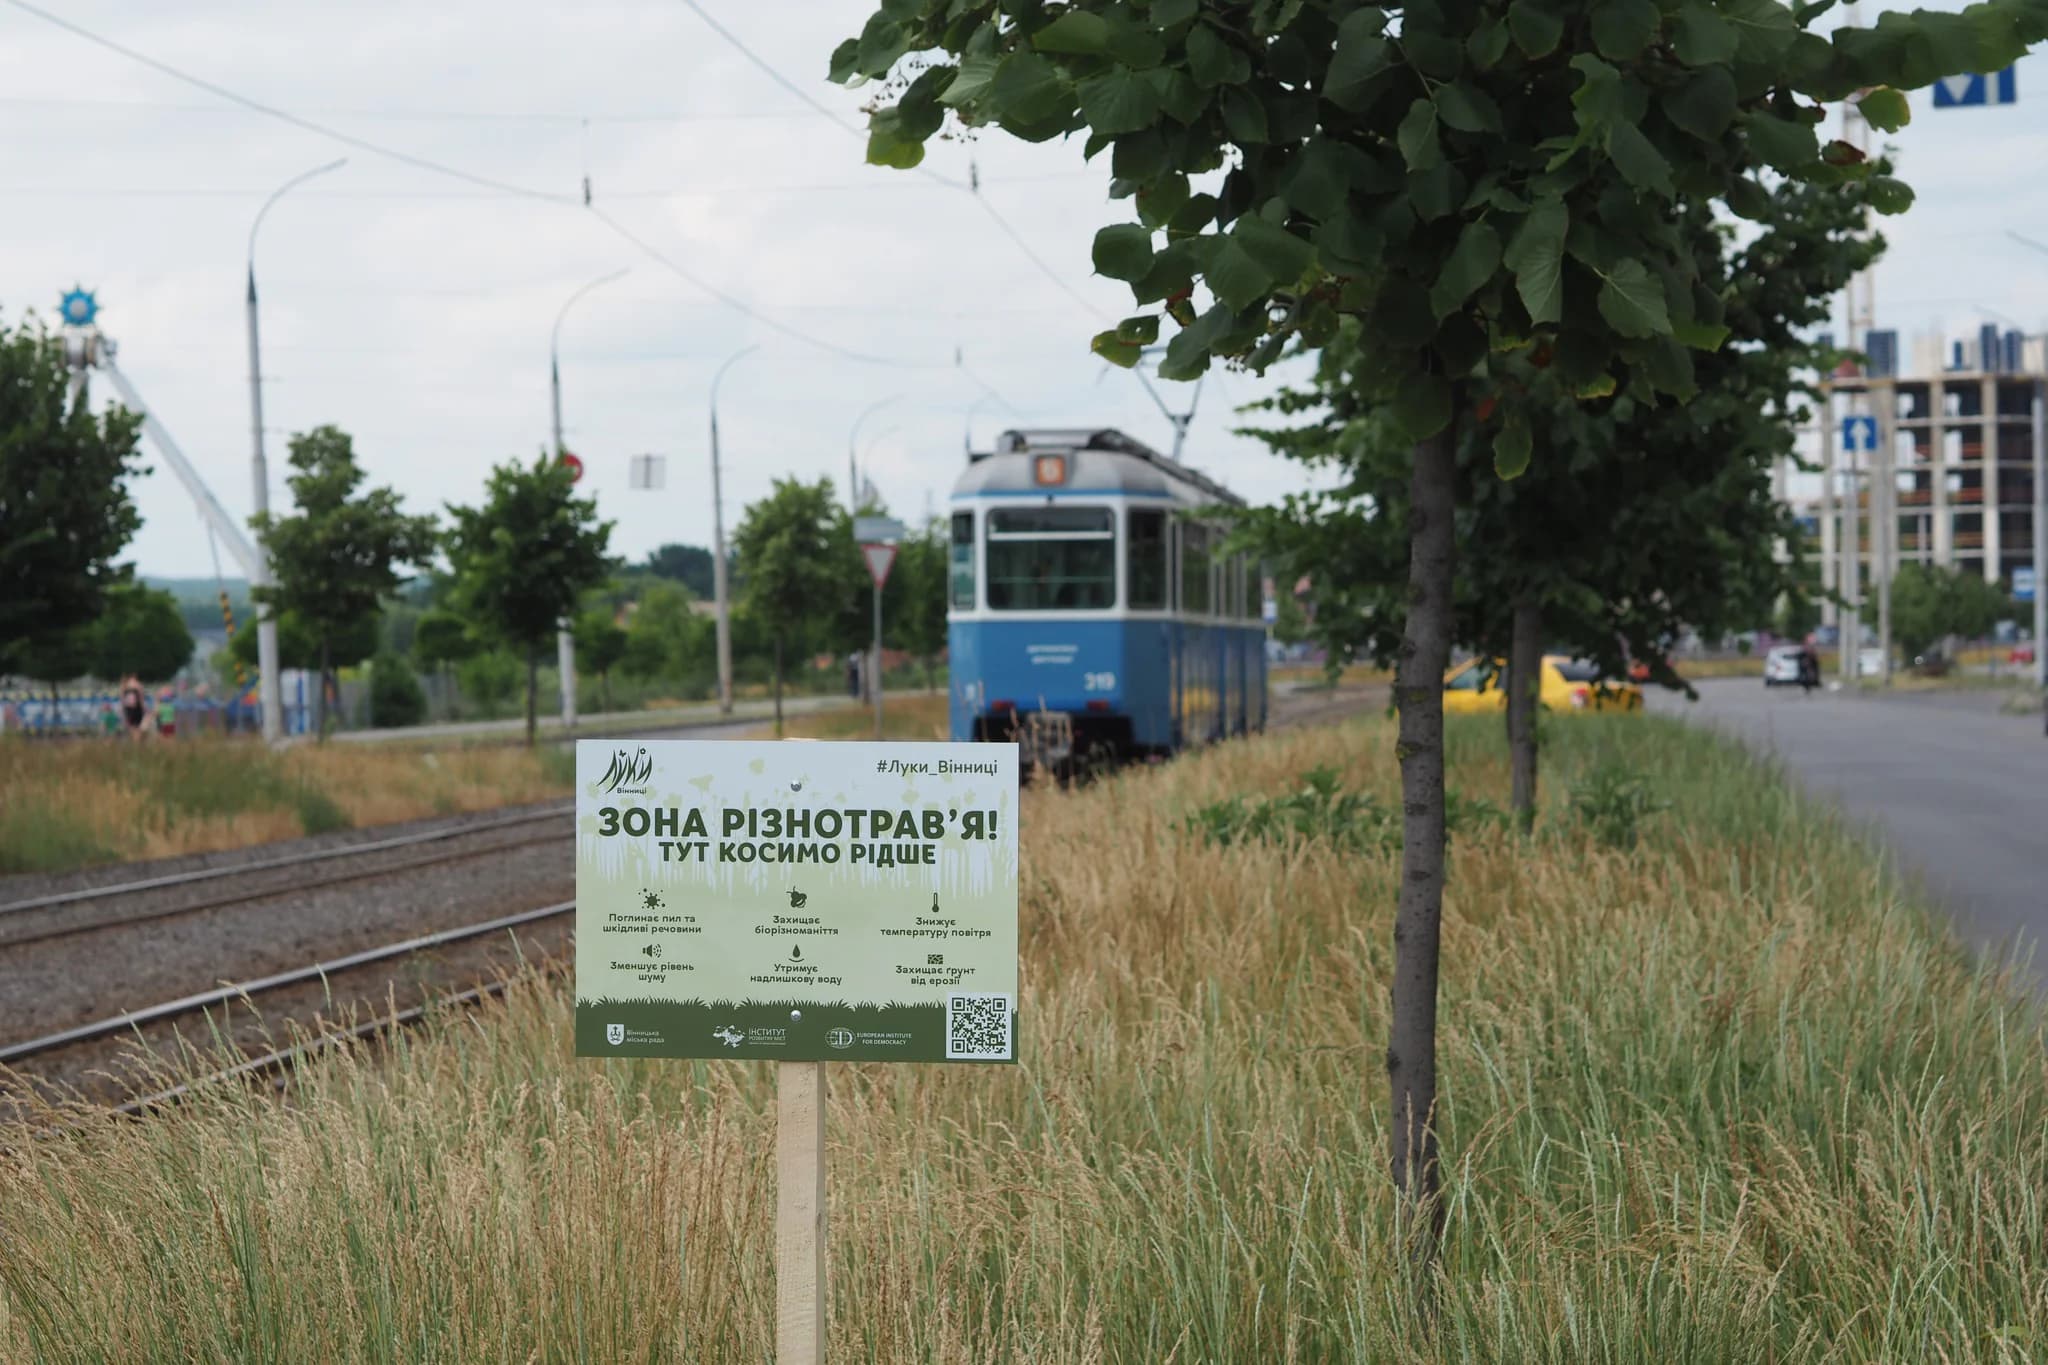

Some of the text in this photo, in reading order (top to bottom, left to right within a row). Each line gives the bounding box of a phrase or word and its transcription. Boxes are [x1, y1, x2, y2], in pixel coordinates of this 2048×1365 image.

[876, 758, 999, 779] #Луки_Вінниці
[616, 787, 647, 796] Вінниці
[598, 806, 709, 838] ЗОНА
[658, 842, 938, 868] ТУТ КОСИМО РІДШЕ
[608, 913, 697, 924] Поглинає пил та
[772, 915, 821, 926] Захищає
[915, 916, 957, 928] Знижує
[602, 924, 702, 937] шкідливі речовини
[754, 926, 840, 938] біорізноманіття
[879, 928, 992, 940] температуру повітря
[609, 961, 695, 974] Зменшує рівень
[773, 964, 819, 976] Утримує
[895, 965, 977, 977] Захищає ґрунт
[638, 974, 667, 984] шуму
[750, 974, 843, 987] надлишкову воду
[910, 974, 962, 987] від ерозії
[749, 1028, 786, 1036] ІНСТИТУТ
